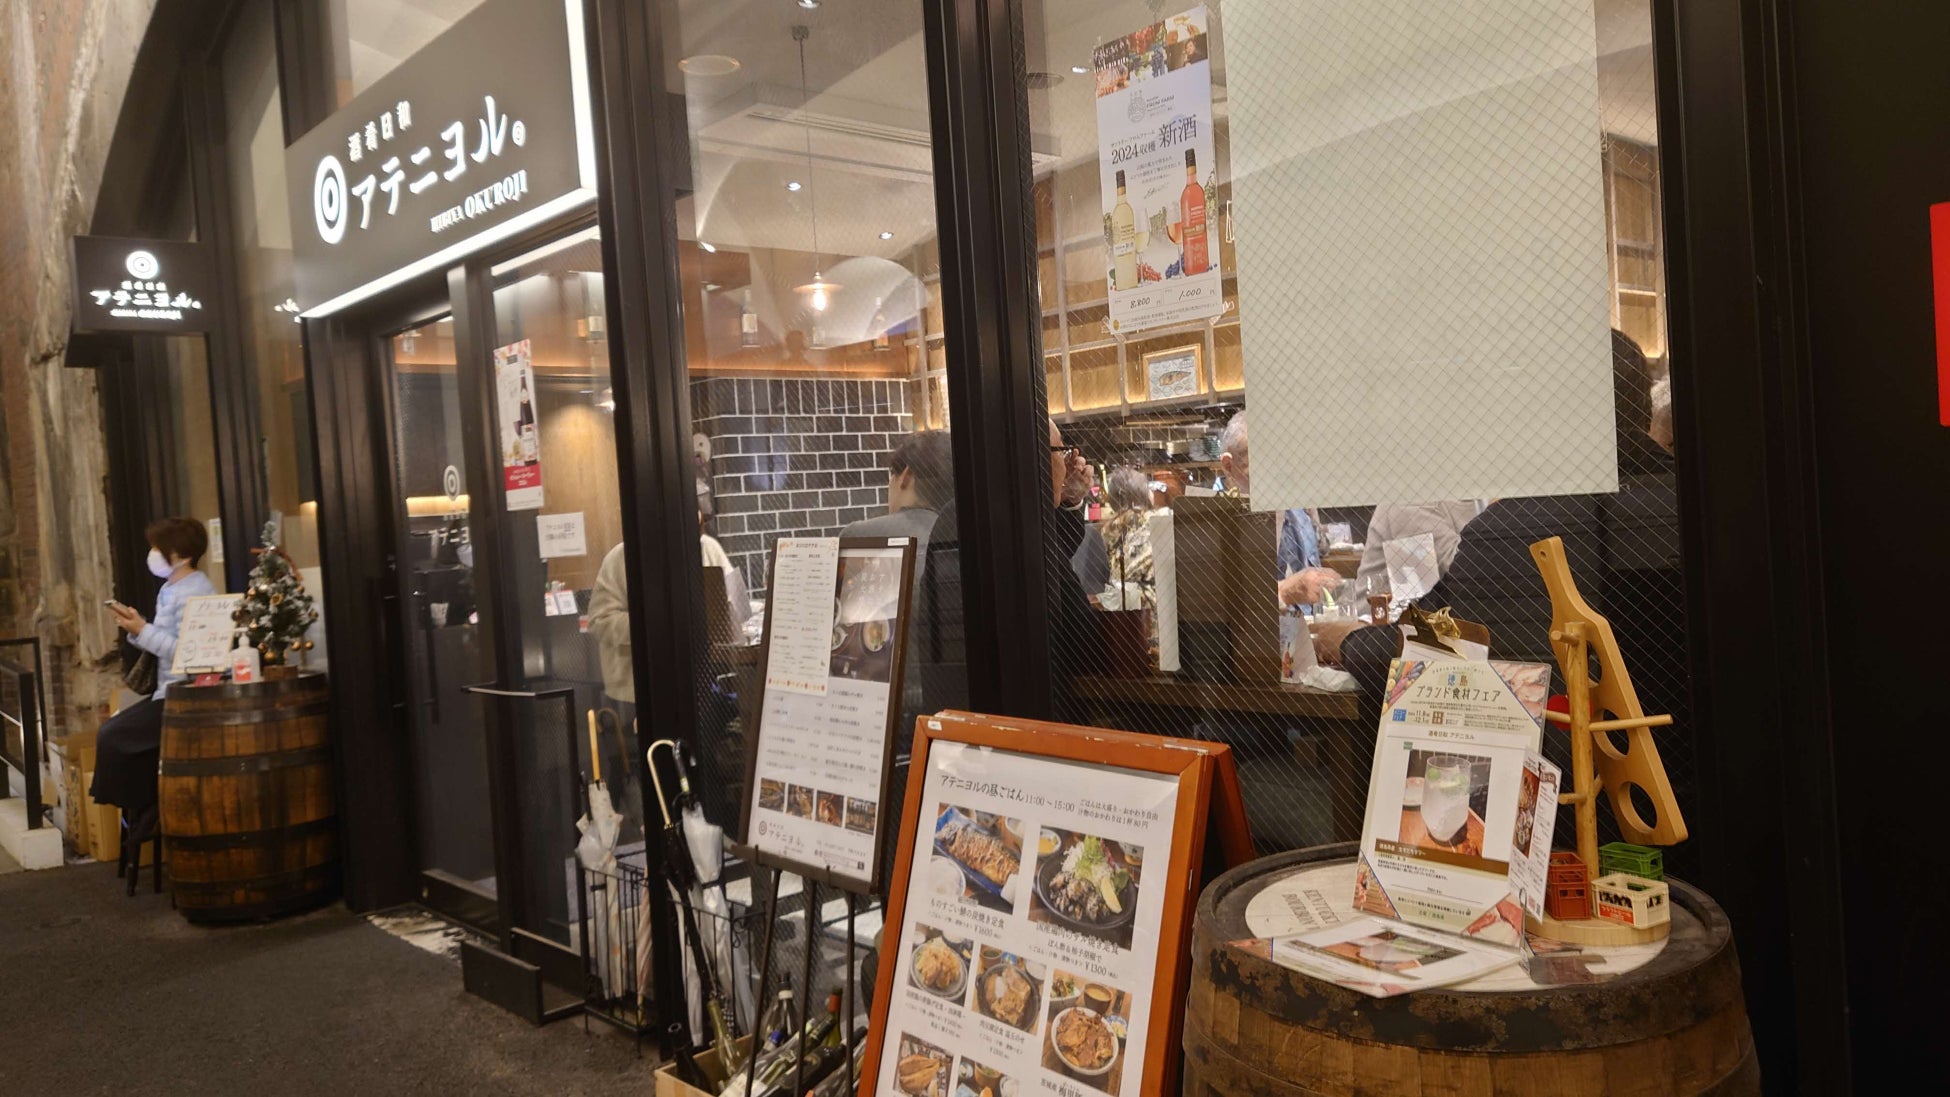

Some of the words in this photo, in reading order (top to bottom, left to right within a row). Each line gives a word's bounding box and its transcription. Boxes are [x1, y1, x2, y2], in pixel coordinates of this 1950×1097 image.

[1159, 114, 1198, 148] 新酒
[464, 169, 529, 219] OKUROJI
[1416, 685, 1502, 702] ブランド食材フェア
[940, 774, 1024, 803] アテニヨルの昼ごはん
